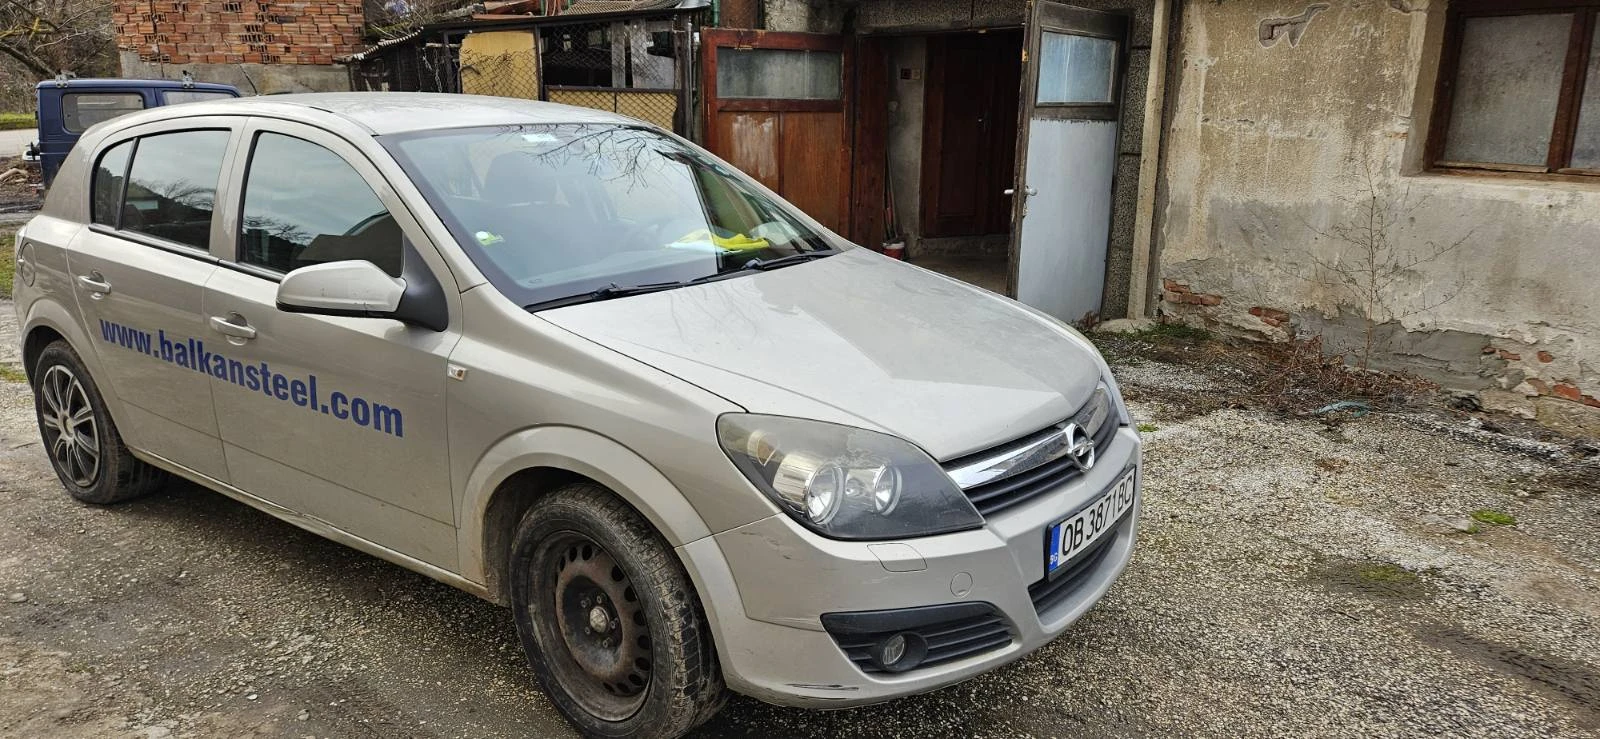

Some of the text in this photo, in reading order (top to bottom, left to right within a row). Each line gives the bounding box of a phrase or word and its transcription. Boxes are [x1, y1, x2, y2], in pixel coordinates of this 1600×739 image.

[99, 318, 404, 438] www.balkansteel.com
[1062, 475, 1132, 556] OB 3871 BC
